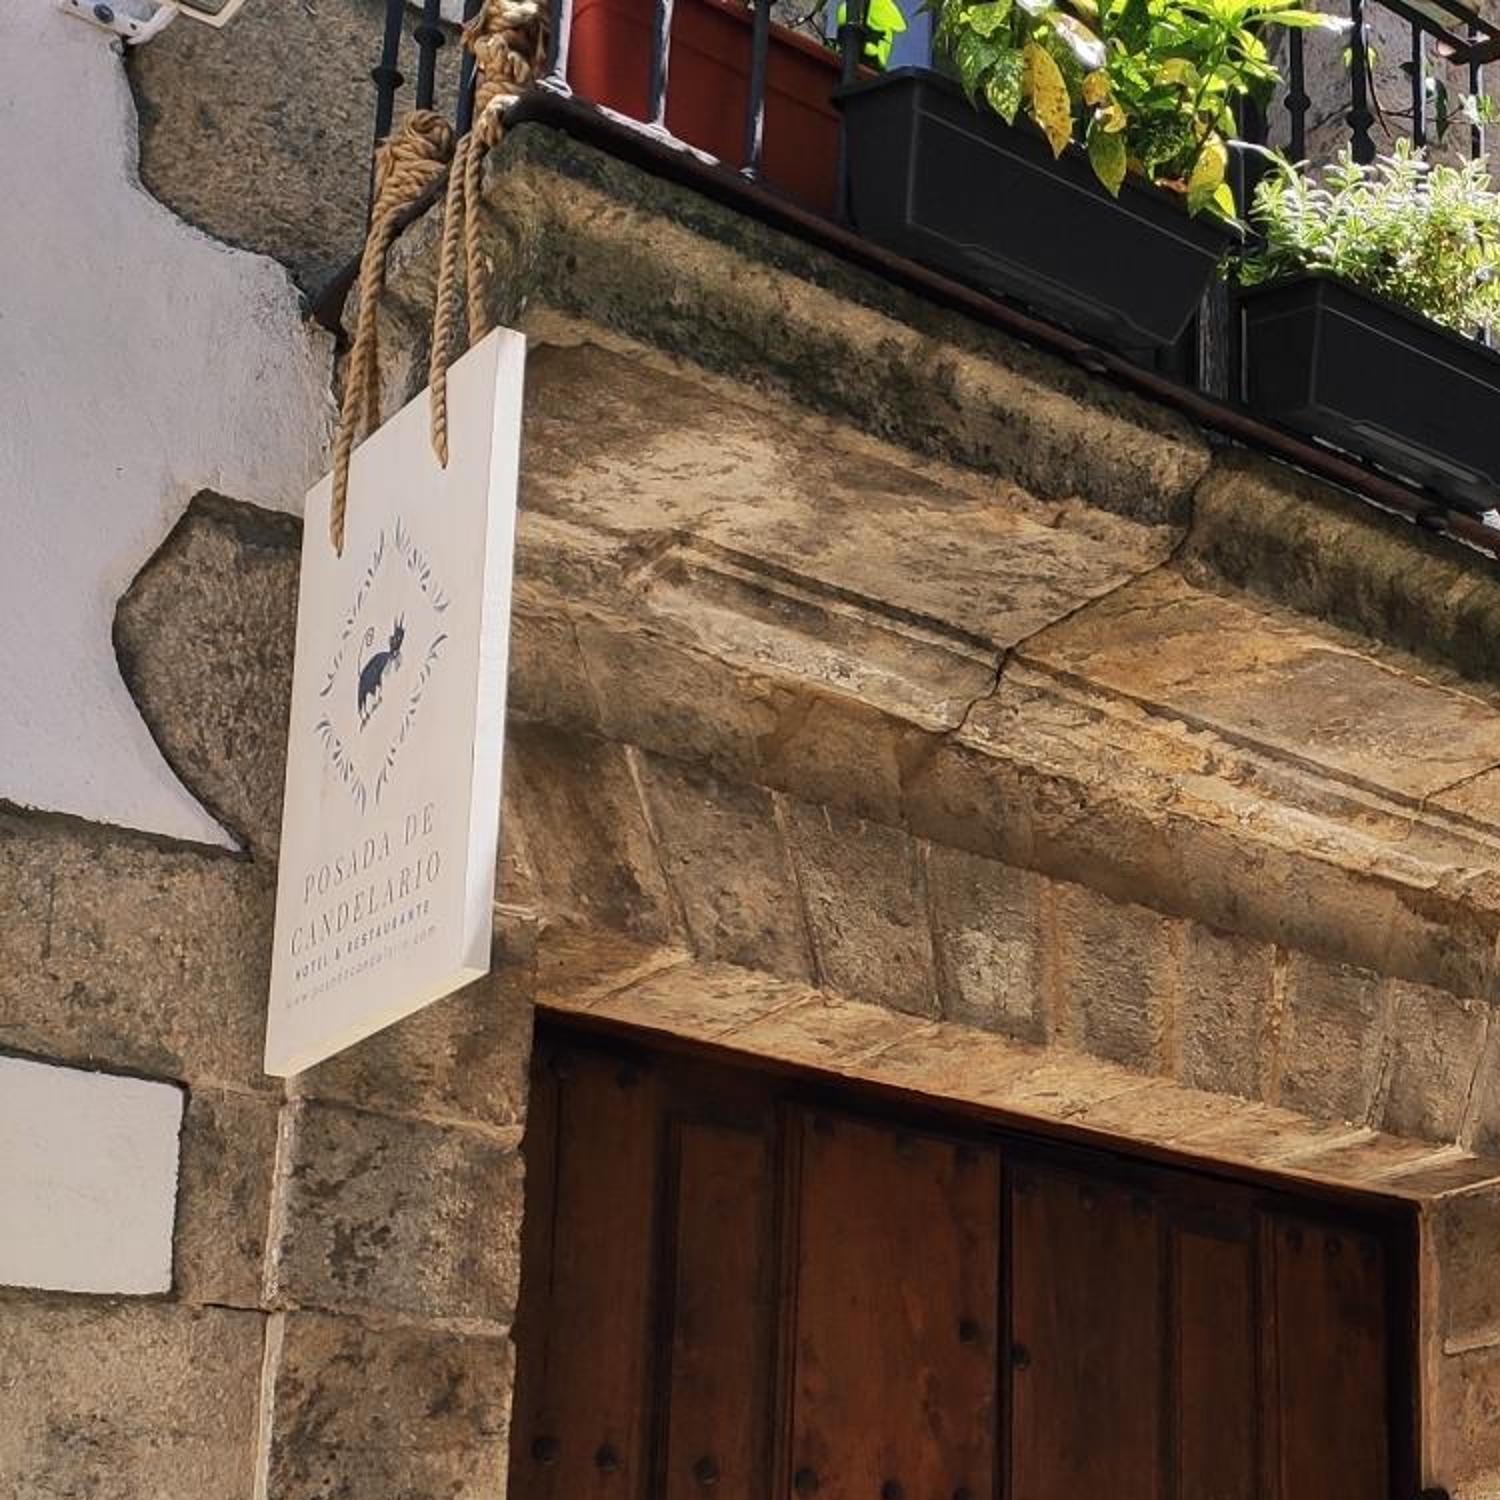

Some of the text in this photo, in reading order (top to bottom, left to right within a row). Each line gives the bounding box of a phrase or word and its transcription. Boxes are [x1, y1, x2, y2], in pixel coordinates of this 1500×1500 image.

[290, 850, 441, 956] CANDELARIO
[303, 802, 435, 904] POSADA DE
[295, 954, 327, 981] HOTEL
[347, 899, 430, 954] RESTAURANTE
